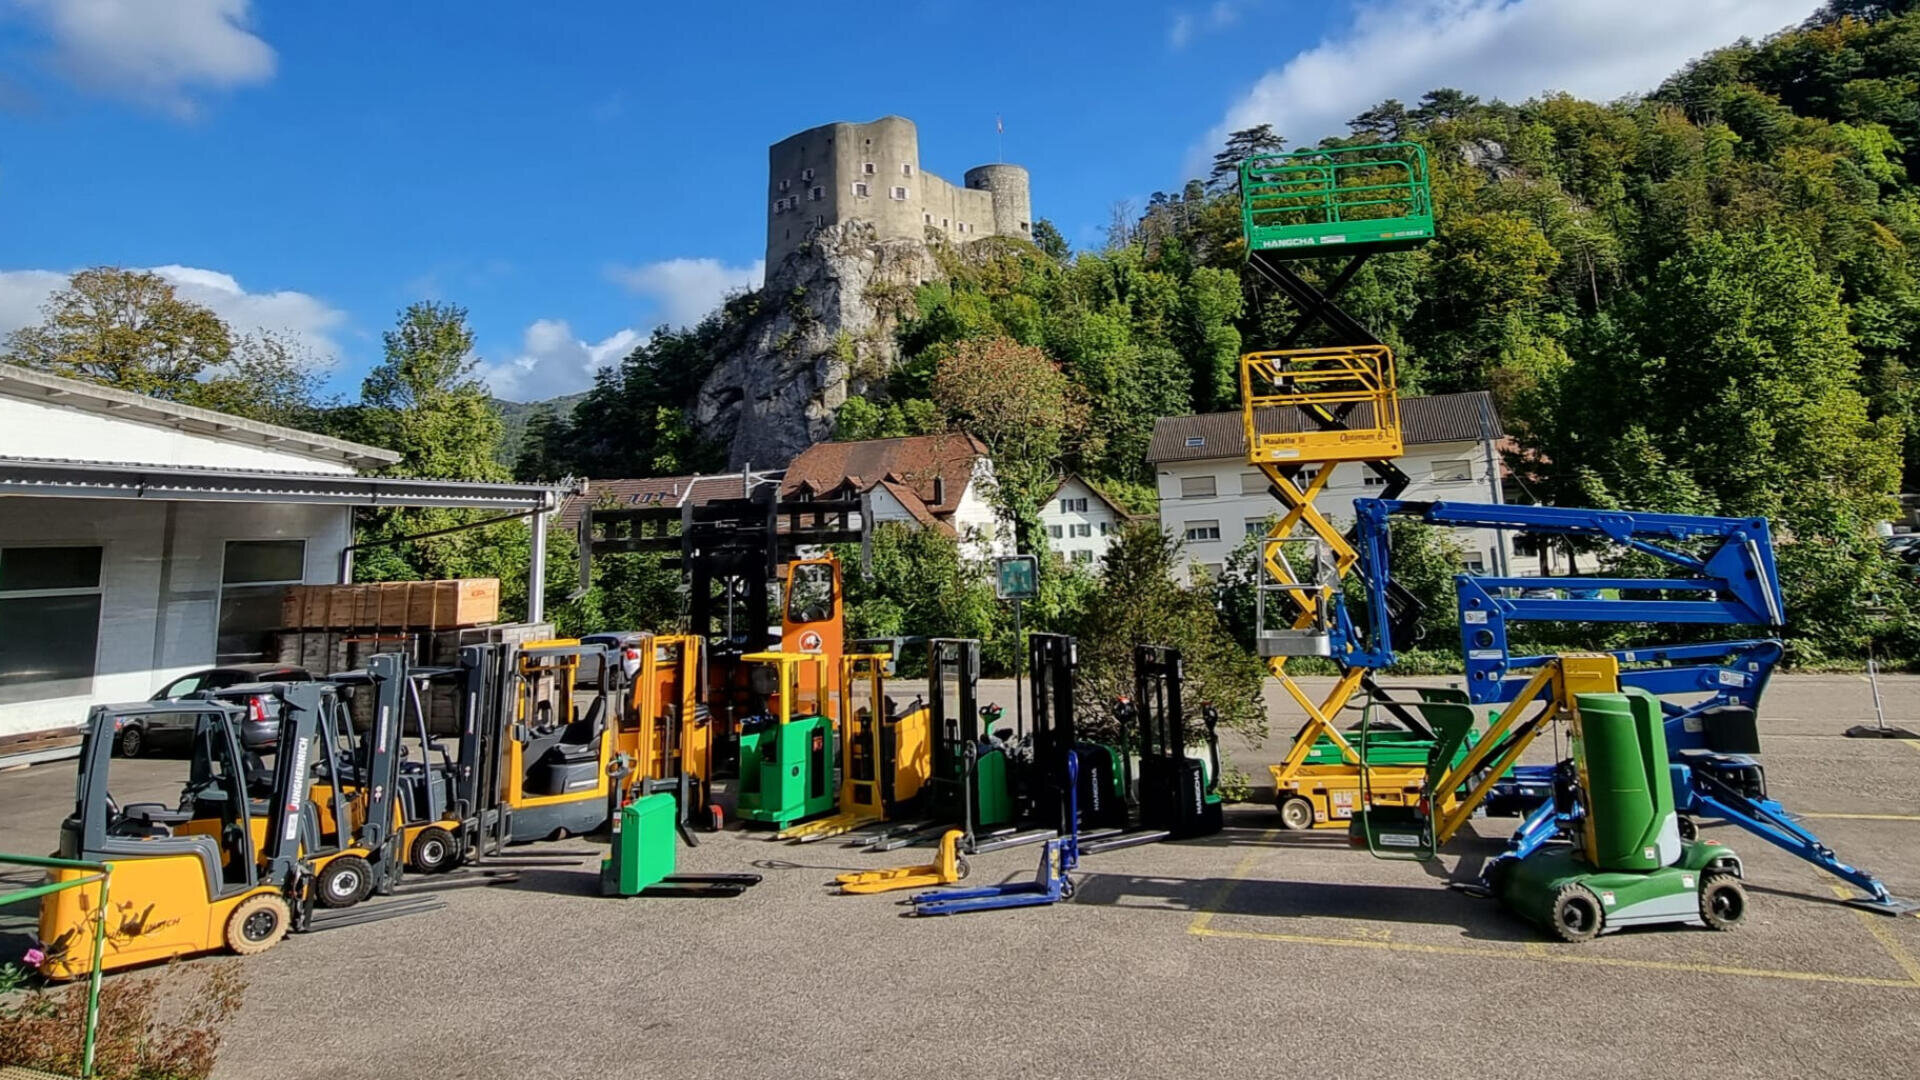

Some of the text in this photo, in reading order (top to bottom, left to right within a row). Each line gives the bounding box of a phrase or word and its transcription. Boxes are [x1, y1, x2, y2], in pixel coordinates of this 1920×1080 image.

[1263, 238, 1315, 248] HANGCHA
[287, 737, 309, 811] JUNGHEINRICH
[1193, 769, 1202, 814] HANGCHA
